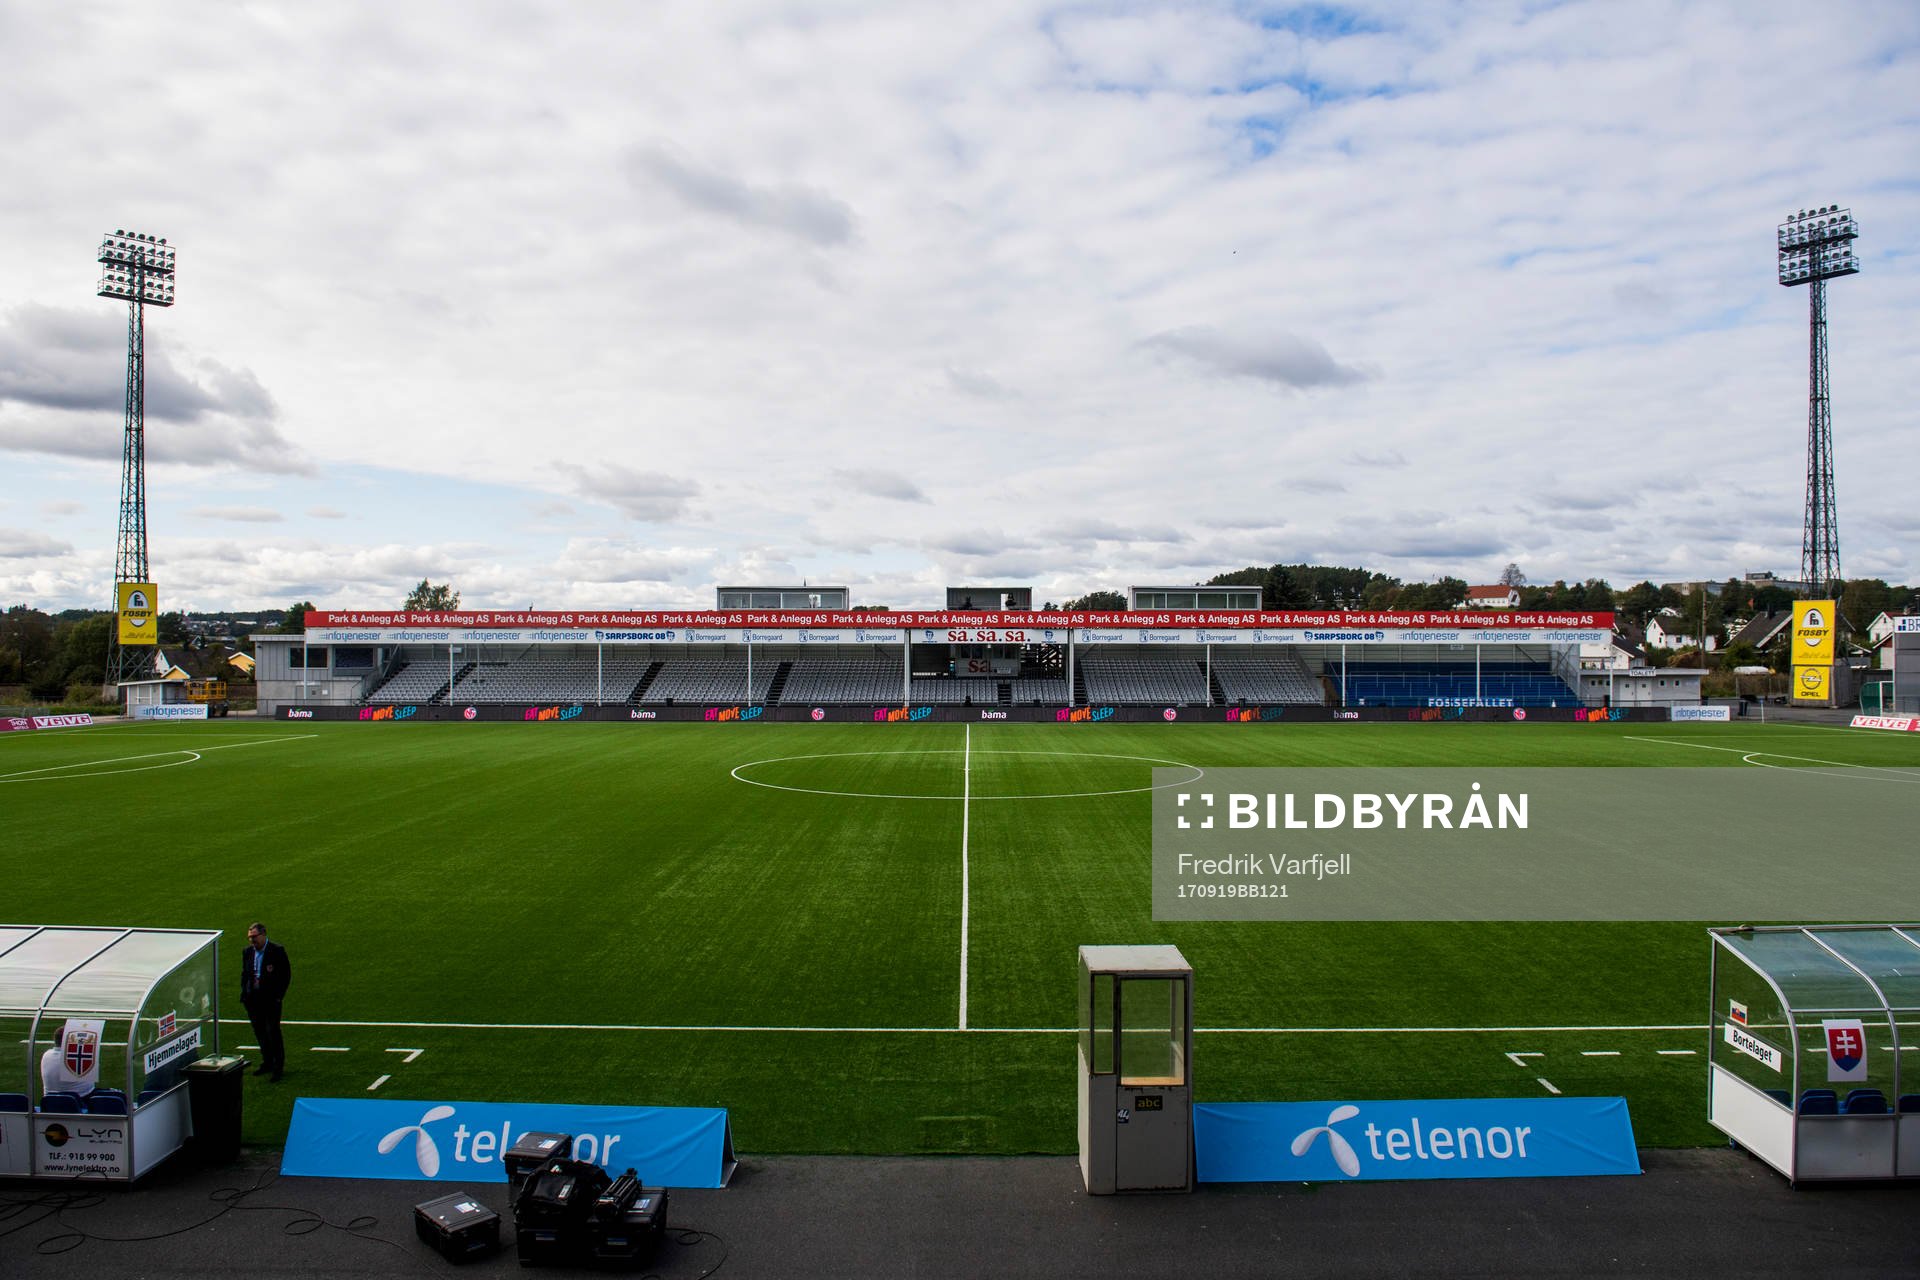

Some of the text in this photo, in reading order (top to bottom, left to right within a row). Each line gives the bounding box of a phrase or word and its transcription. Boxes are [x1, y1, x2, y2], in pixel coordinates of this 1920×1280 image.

[329, 614, 407, 625] Park & Anlegg AS
[412, 614, 490, 625] Park & Anlegg AS
[495, 614, 574, 625] Park & Anlegg AS
[579, 614, 658, 625] Park & Anlegg AS
[663, 614, 743, 625] Park & Anlegg AS
[748, 614, 828, 625] Park & Anlegg AS
[833, 614, 913, 625] Park & Anlegg AS
[919, 614, 999, 625] Park & Anlegg AS
[1004, 614, 1085, 625] Park & Anlegg AS
[1090, 614, 1170, 625] Park & Anlegg AS
[1176, 614, 1256, 625] Park & Anlegg AS
[1261, 614, 1341, 625] Park & Anlegg AS
[1346, 614, 1426, 625] Park & Anlegg AS
[1431, 614, 1510, 625] Park & Anlegg AS
[1515, 614, 1594, 625] Park & Anlegg AS
[326, 631, 382, 642] infotjenester
[394, 631, 450, 642] infotjenester
[464, 631, 521, 642] infotjenester
[532, 631, 589, 642] infotjenester
[605, 632, 666, 640] SARPSBORG 08
[695, 633, 726, 642] Borregaard
[752, 633, 783, 642] Borregaard
[808, 633, 839, 642] Borregaard
[865, 633, 896, 642] Borregaard
[1091, 633, 1123, 642] Borregaard
[1149, 633, 1180, 642] Borregaard
[1206, 633, 1237, 642] Borregaard
[1263, 633, 1294, 642] Borregaard
[1314, 632, 1375, 640] SARPSBORG 08
[1402, 631, 1460, 642] infotjenester
[1475, 631, 1531, 642] infotjenester
[1546, 631, 1602, 642] infotjenester
[1797, 629, 1829, 637] FOSBY
[359, 706, 417, 720] EAT MOVE SLEEP
[525, 706, 582, 721] EAT MOVE SLEEP
[631, 709, 656, 718] bama
[705, 706, 762, 721] EAT MOVE SLEEP
[874, 707, 932, 721] EAT MOVE SLEEP
[981, 710, 1007, 719] bama
[1056, 706, 1114, 721] EAT MOVE SLEEP
[1226, 708, 1240, 721] EAT
[1240, 707, 1261, 721] MOVE
[1333, 710, 1358, 719] bama
[1575, 707, 1587, 720] EAT
[1588, 706, 1609, 721] MOVE
[1855, 717, 1879, 727] VG
[1882, 719, 1908, 729] VG
[148, 1032, 198, 1068] Hjemmelaget
[1733, 1029, 1773, 1063] Bortelaget
[1138, 1097, 1161, 1108] abc
[454, 1121, 620, 1166] telor
[1365, 1117, 1531, 1161] telenor
[69, 1152, 85, 1160] 918
[88, 1152, 98, 1161] 99
[100, 1153, 115, 1161] 900
